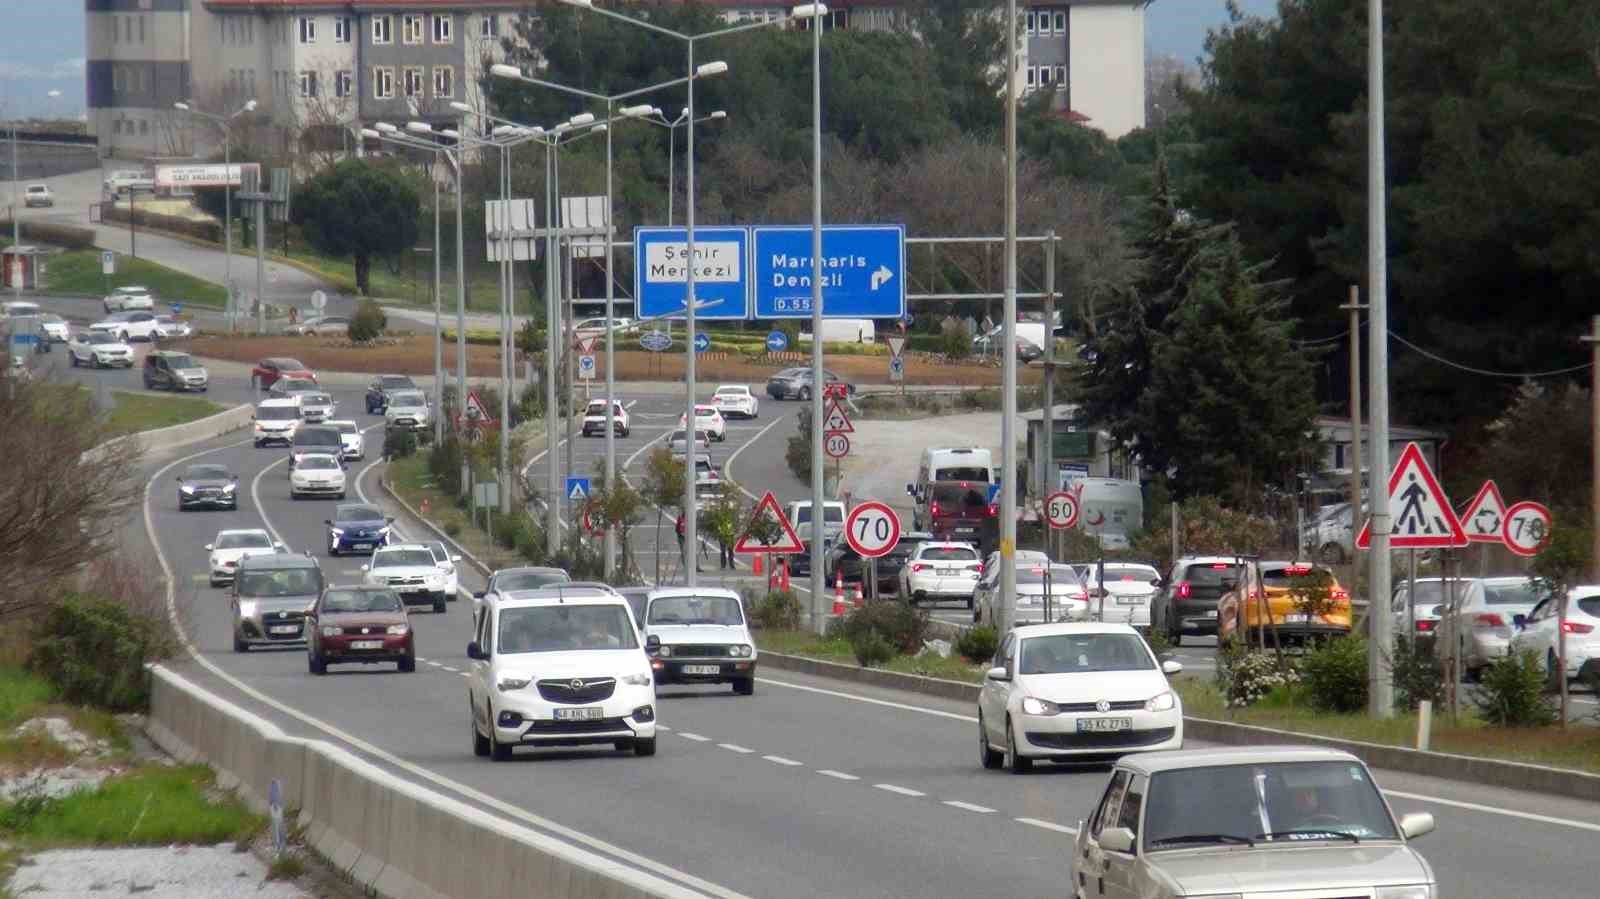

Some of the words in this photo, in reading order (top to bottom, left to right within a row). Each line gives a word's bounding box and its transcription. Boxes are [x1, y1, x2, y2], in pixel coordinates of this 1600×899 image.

[665, 246, 719, 260] Şehir
[773, 273, 843, 287] Denzli
[777, 300, 818, 310] D.55
[831, 440, 845, 451] 30
[857, 517, 889, 541] 70
